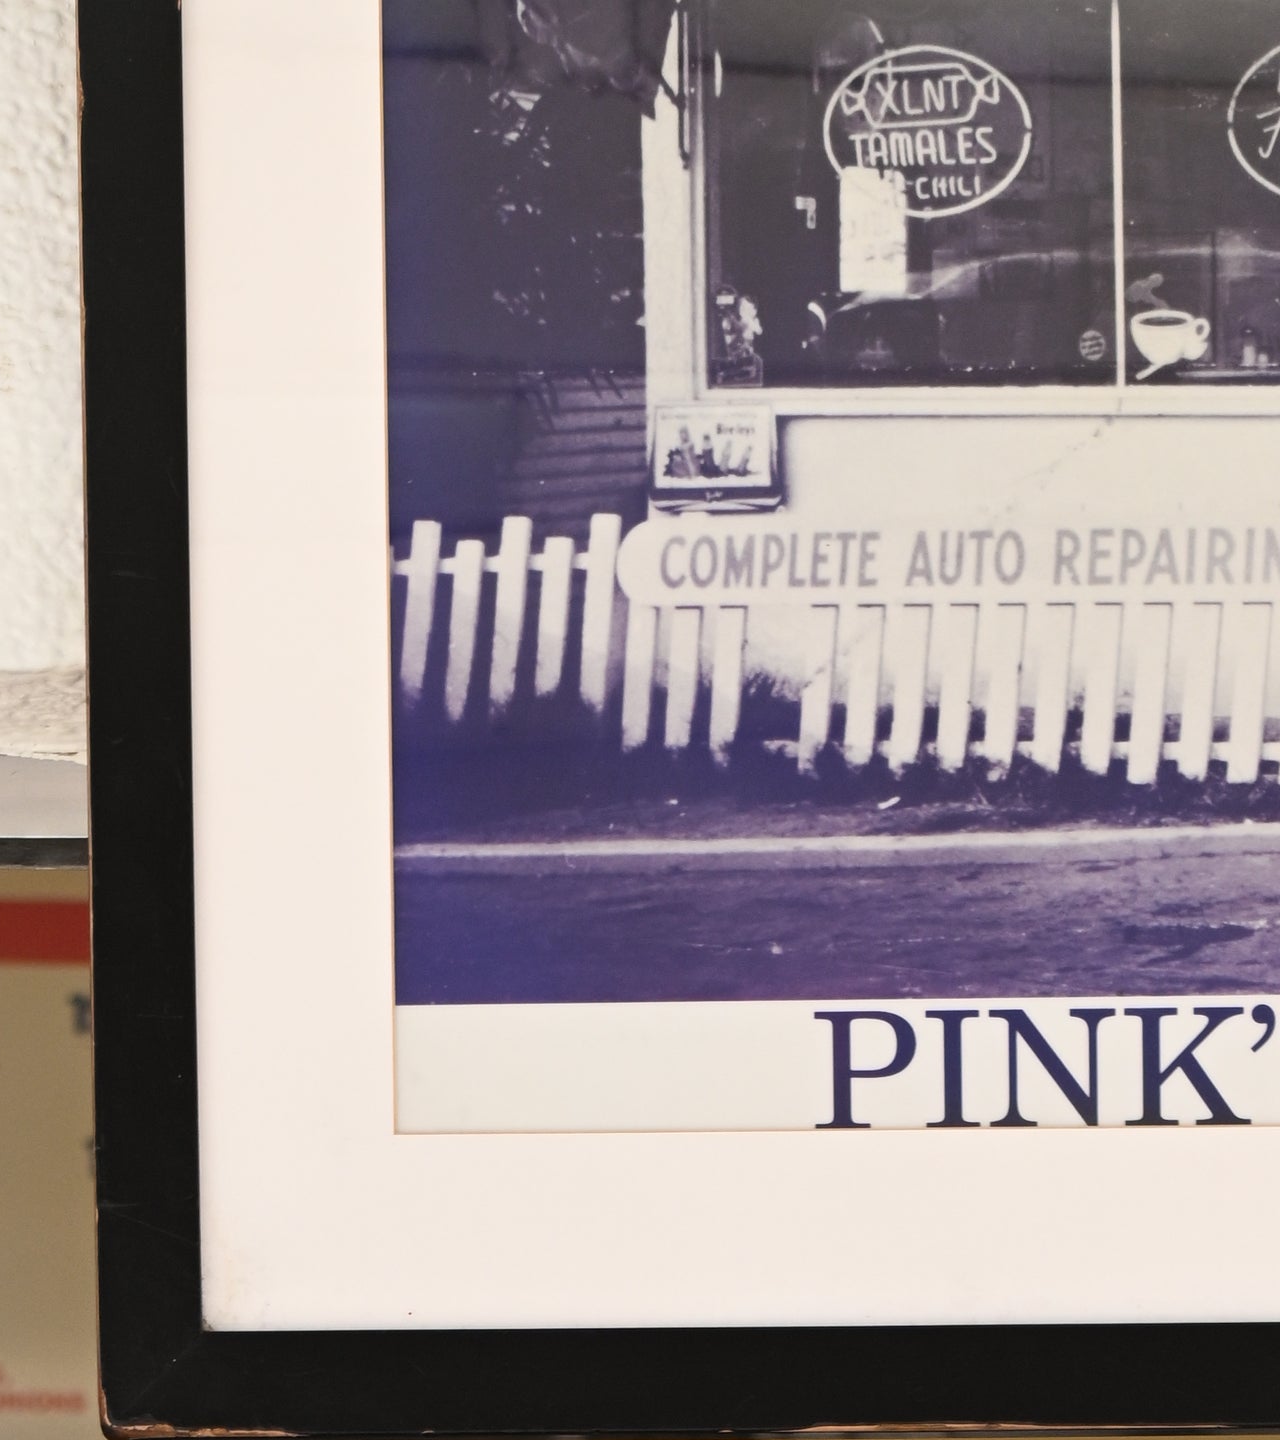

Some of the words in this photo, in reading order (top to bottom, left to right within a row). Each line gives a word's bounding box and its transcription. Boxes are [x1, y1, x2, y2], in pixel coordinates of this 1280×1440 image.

[875, 76, 966, 122] XLNT
[849, 128, 997, 168] TAMALES
[660, 531, 881, 590] COMPLETE
[905, 528, 1026, 587] AUTO
